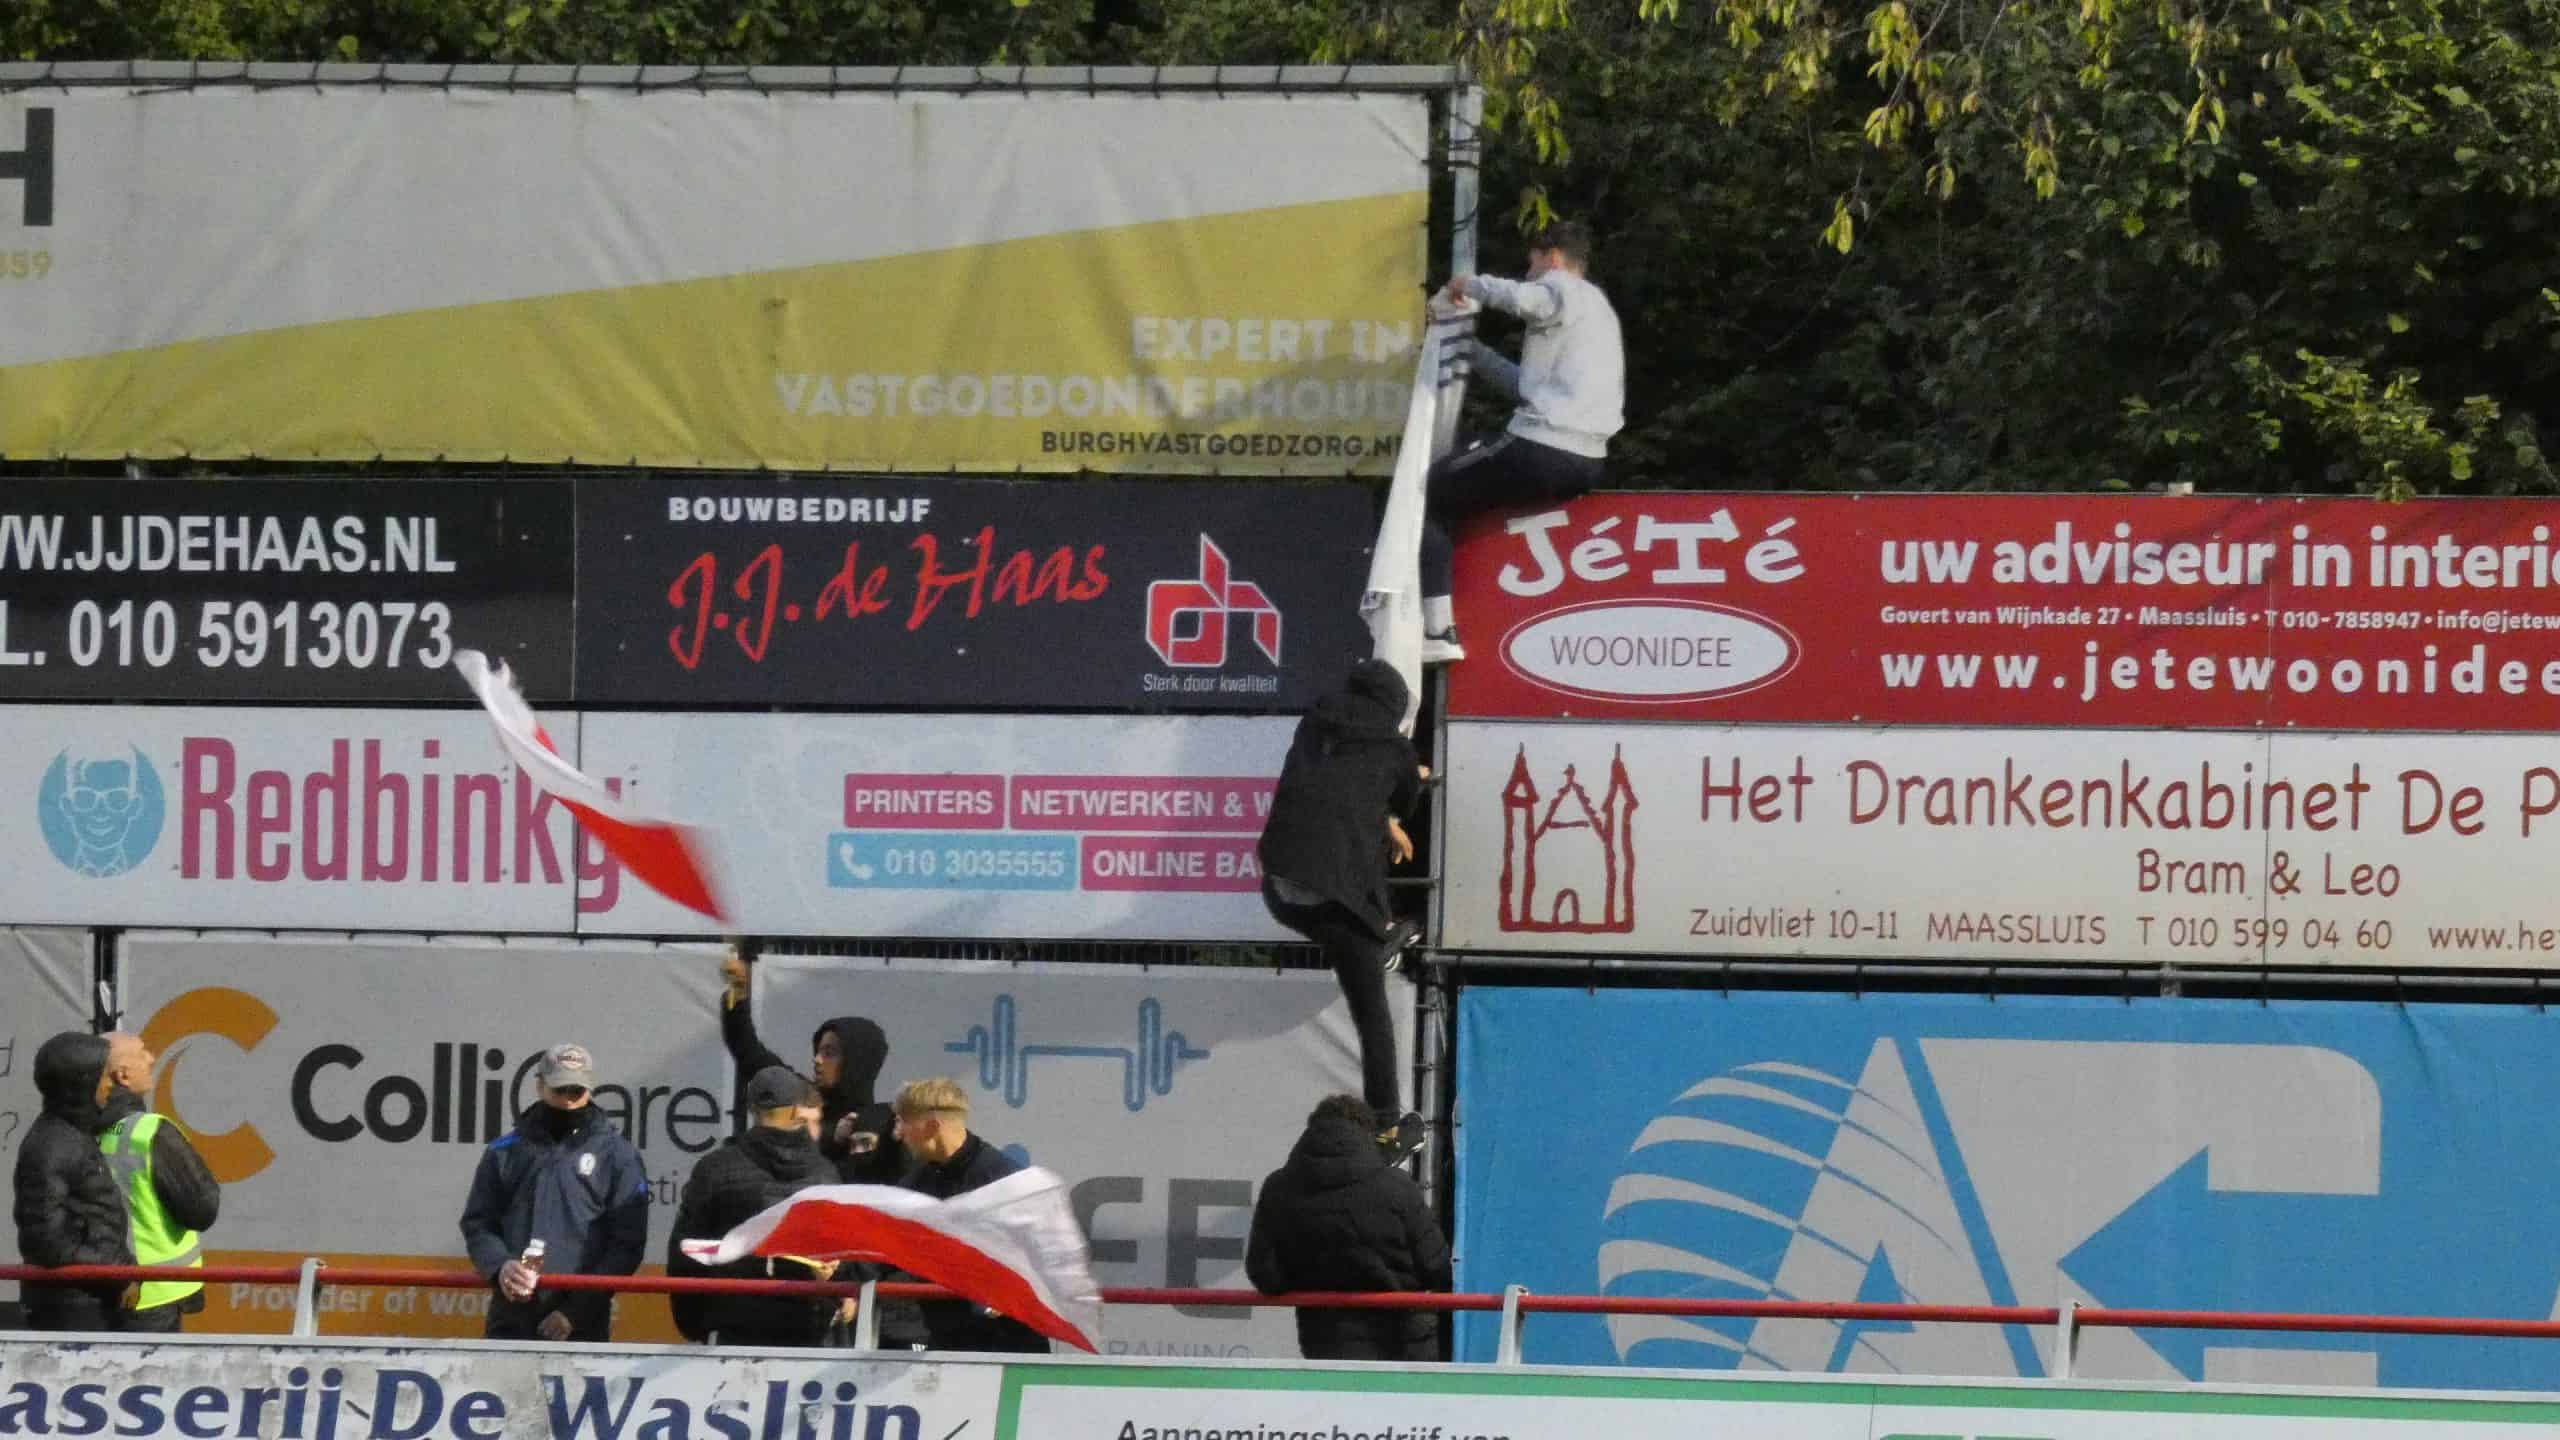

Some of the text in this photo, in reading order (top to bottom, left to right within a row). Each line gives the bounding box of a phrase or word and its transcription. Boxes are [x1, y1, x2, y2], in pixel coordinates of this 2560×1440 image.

[1132, 318, 1412, 363] EXPERT IN
[776, 375, 1411, 420] VASTGOEDONDERHOUD
[669, 497, 932, 523] BOUWBEDRIJF
[0, 515, 456, 572] W.JJDEHAAS.NL
[1498, 509, 1805, 597] JéTé
[1881, 522, 2560, 589] uw adviseur in interi
[816, 541, 890, 621] de
[906, 526, 1109, 631] Haas
[69, 600, 176, 668] 010
[198, 602, 453, 669] 5913073
[1881, 606, 1950, 624] Govert
[1956, 610, 1991, 625] van
[1996, 607, 2090, 629] Wijnkade
[2098, 608, 2120, 625] 27
[2139, 607, 2246, 626] Maassluis
[2264, 609, 2278, 627] T
[1551, 636, 1731, 668] WOONIDEE
[1143, 673, 1278, 694] Sterk door kwaliteit
[854, 789, 993, 815] PRINTERS
[1021, 791, 1275, 817] NETWERKEN & W
[1700, 756, 2560, 838] Het Drankenkabinet De P
[886, 848, 1064, 877] 010 3035555
[1093, 851, 1262, 878] ONLINE BA
[2137, 848, 2400, 896] Bram & Leo
[1689, 909, 2560, 950] Zuidvliet 10-11 MAASSLUIS T 010 599 04 60 www.he
[230, 1283, 368, 1316] Provder
[384, 1286, 417, 1313] of
[368, 1369, 503, 1440] De
[541, 1376, 921, 1440] Waslijn
